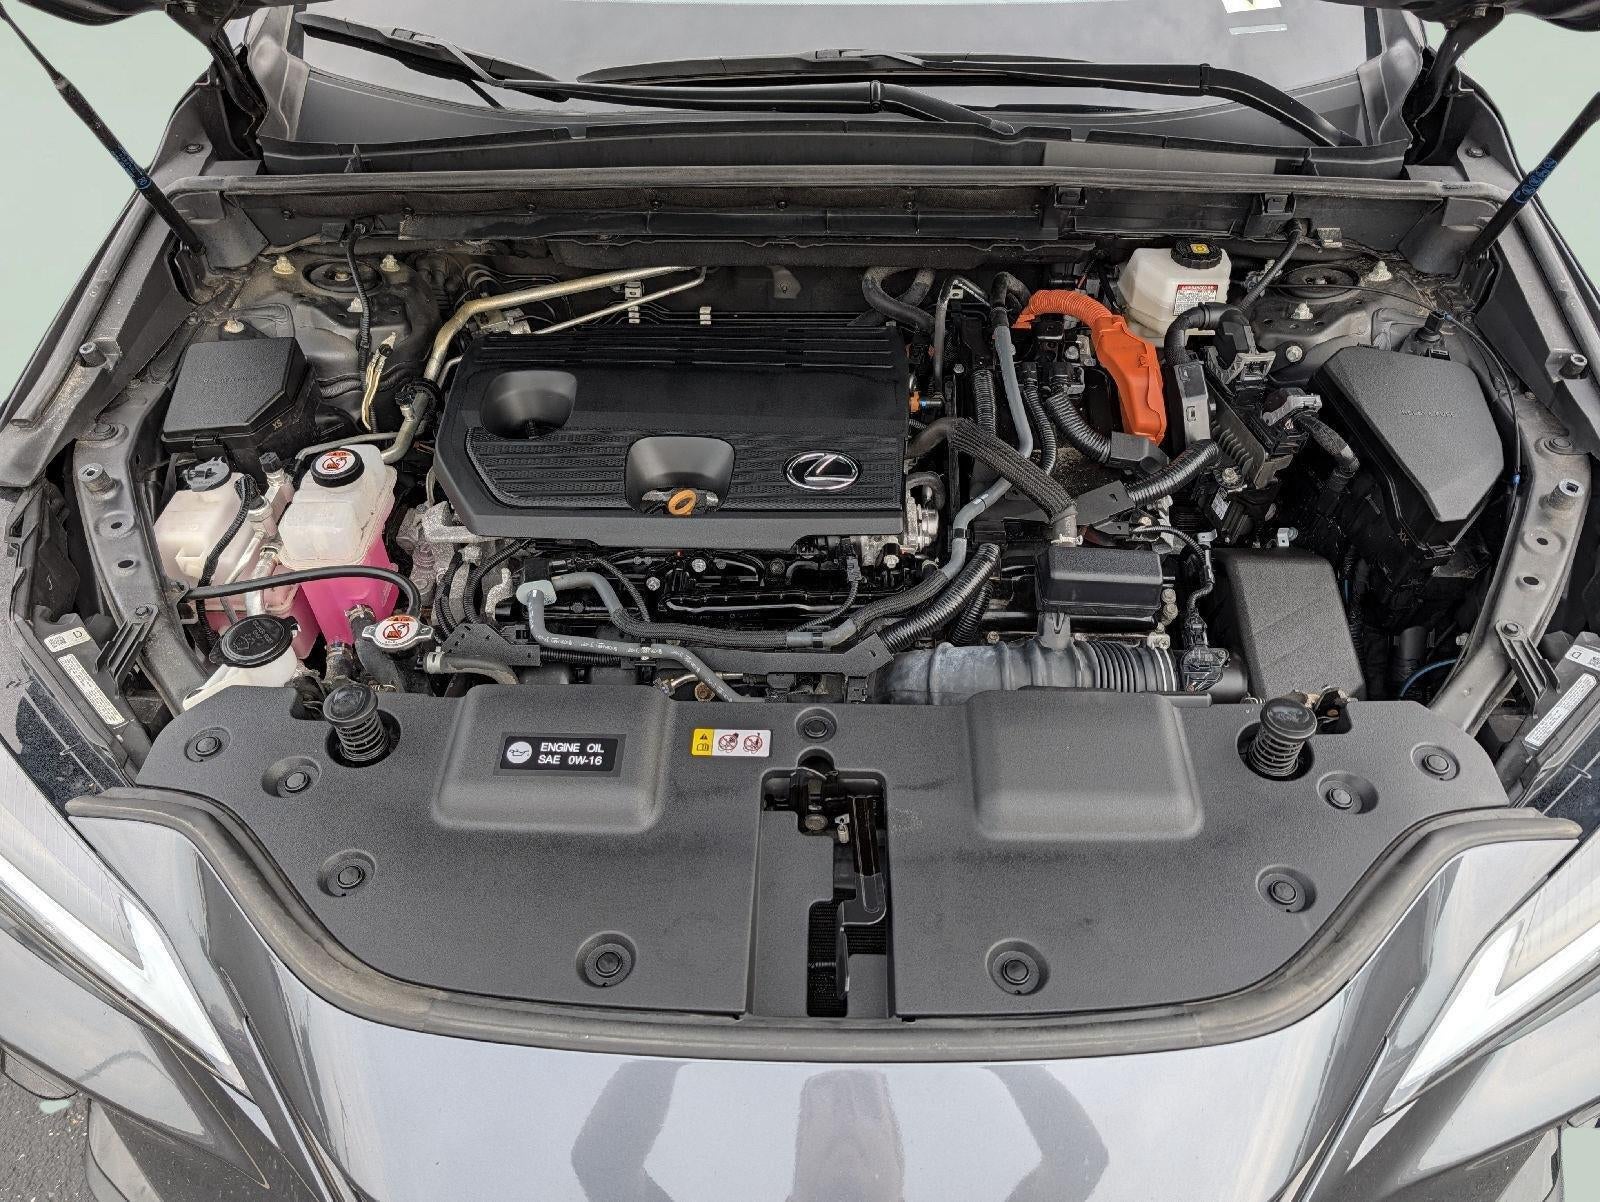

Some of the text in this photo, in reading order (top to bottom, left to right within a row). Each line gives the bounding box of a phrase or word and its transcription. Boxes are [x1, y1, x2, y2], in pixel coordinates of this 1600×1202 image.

[540, 742, 605, 753] ENGINE OIL
[538, 754, 603, 766] SAE 0W-16
